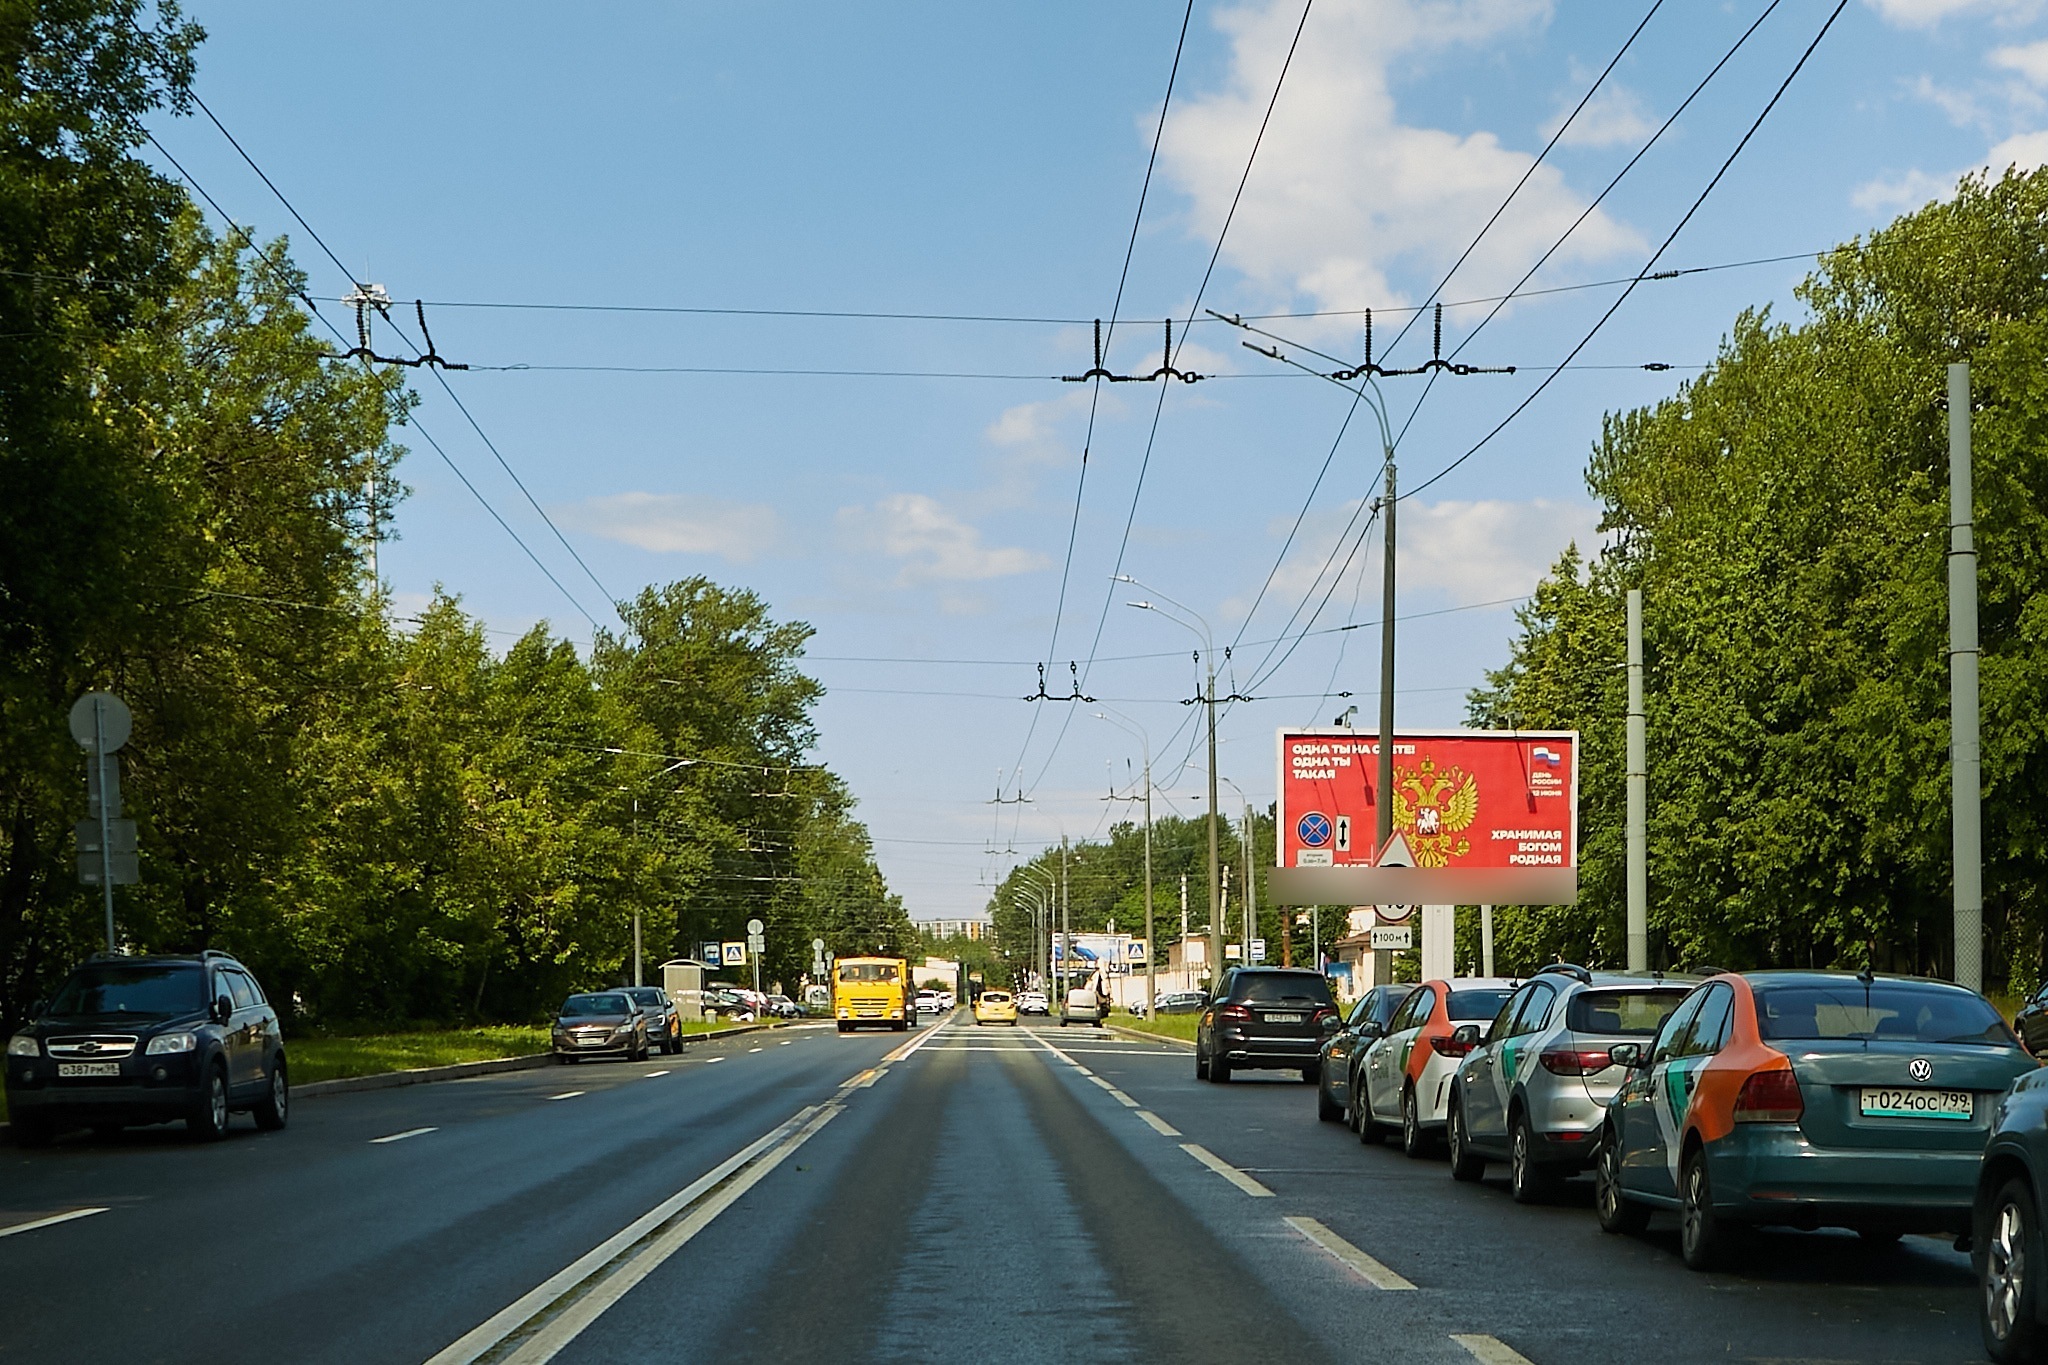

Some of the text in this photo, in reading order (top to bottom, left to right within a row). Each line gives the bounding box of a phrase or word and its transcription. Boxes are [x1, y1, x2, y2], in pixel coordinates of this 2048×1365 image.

[1292, 744, 1330, 755] ОДНА
[1332, 744, 1350, 755] ТЫ
[1352, 744, 1371, 755] НА
[1292, 757, 1351, 767] ОДНА ТЫ
[1293, 769, 1336, 780] ТАКАЯ
[1491, 830, 1562, 840] ХРАНИМАЯ
[1518, 842, 1562, 852] БОГОМ
[1509, 854, 1562, 866] РОДНАЯ
